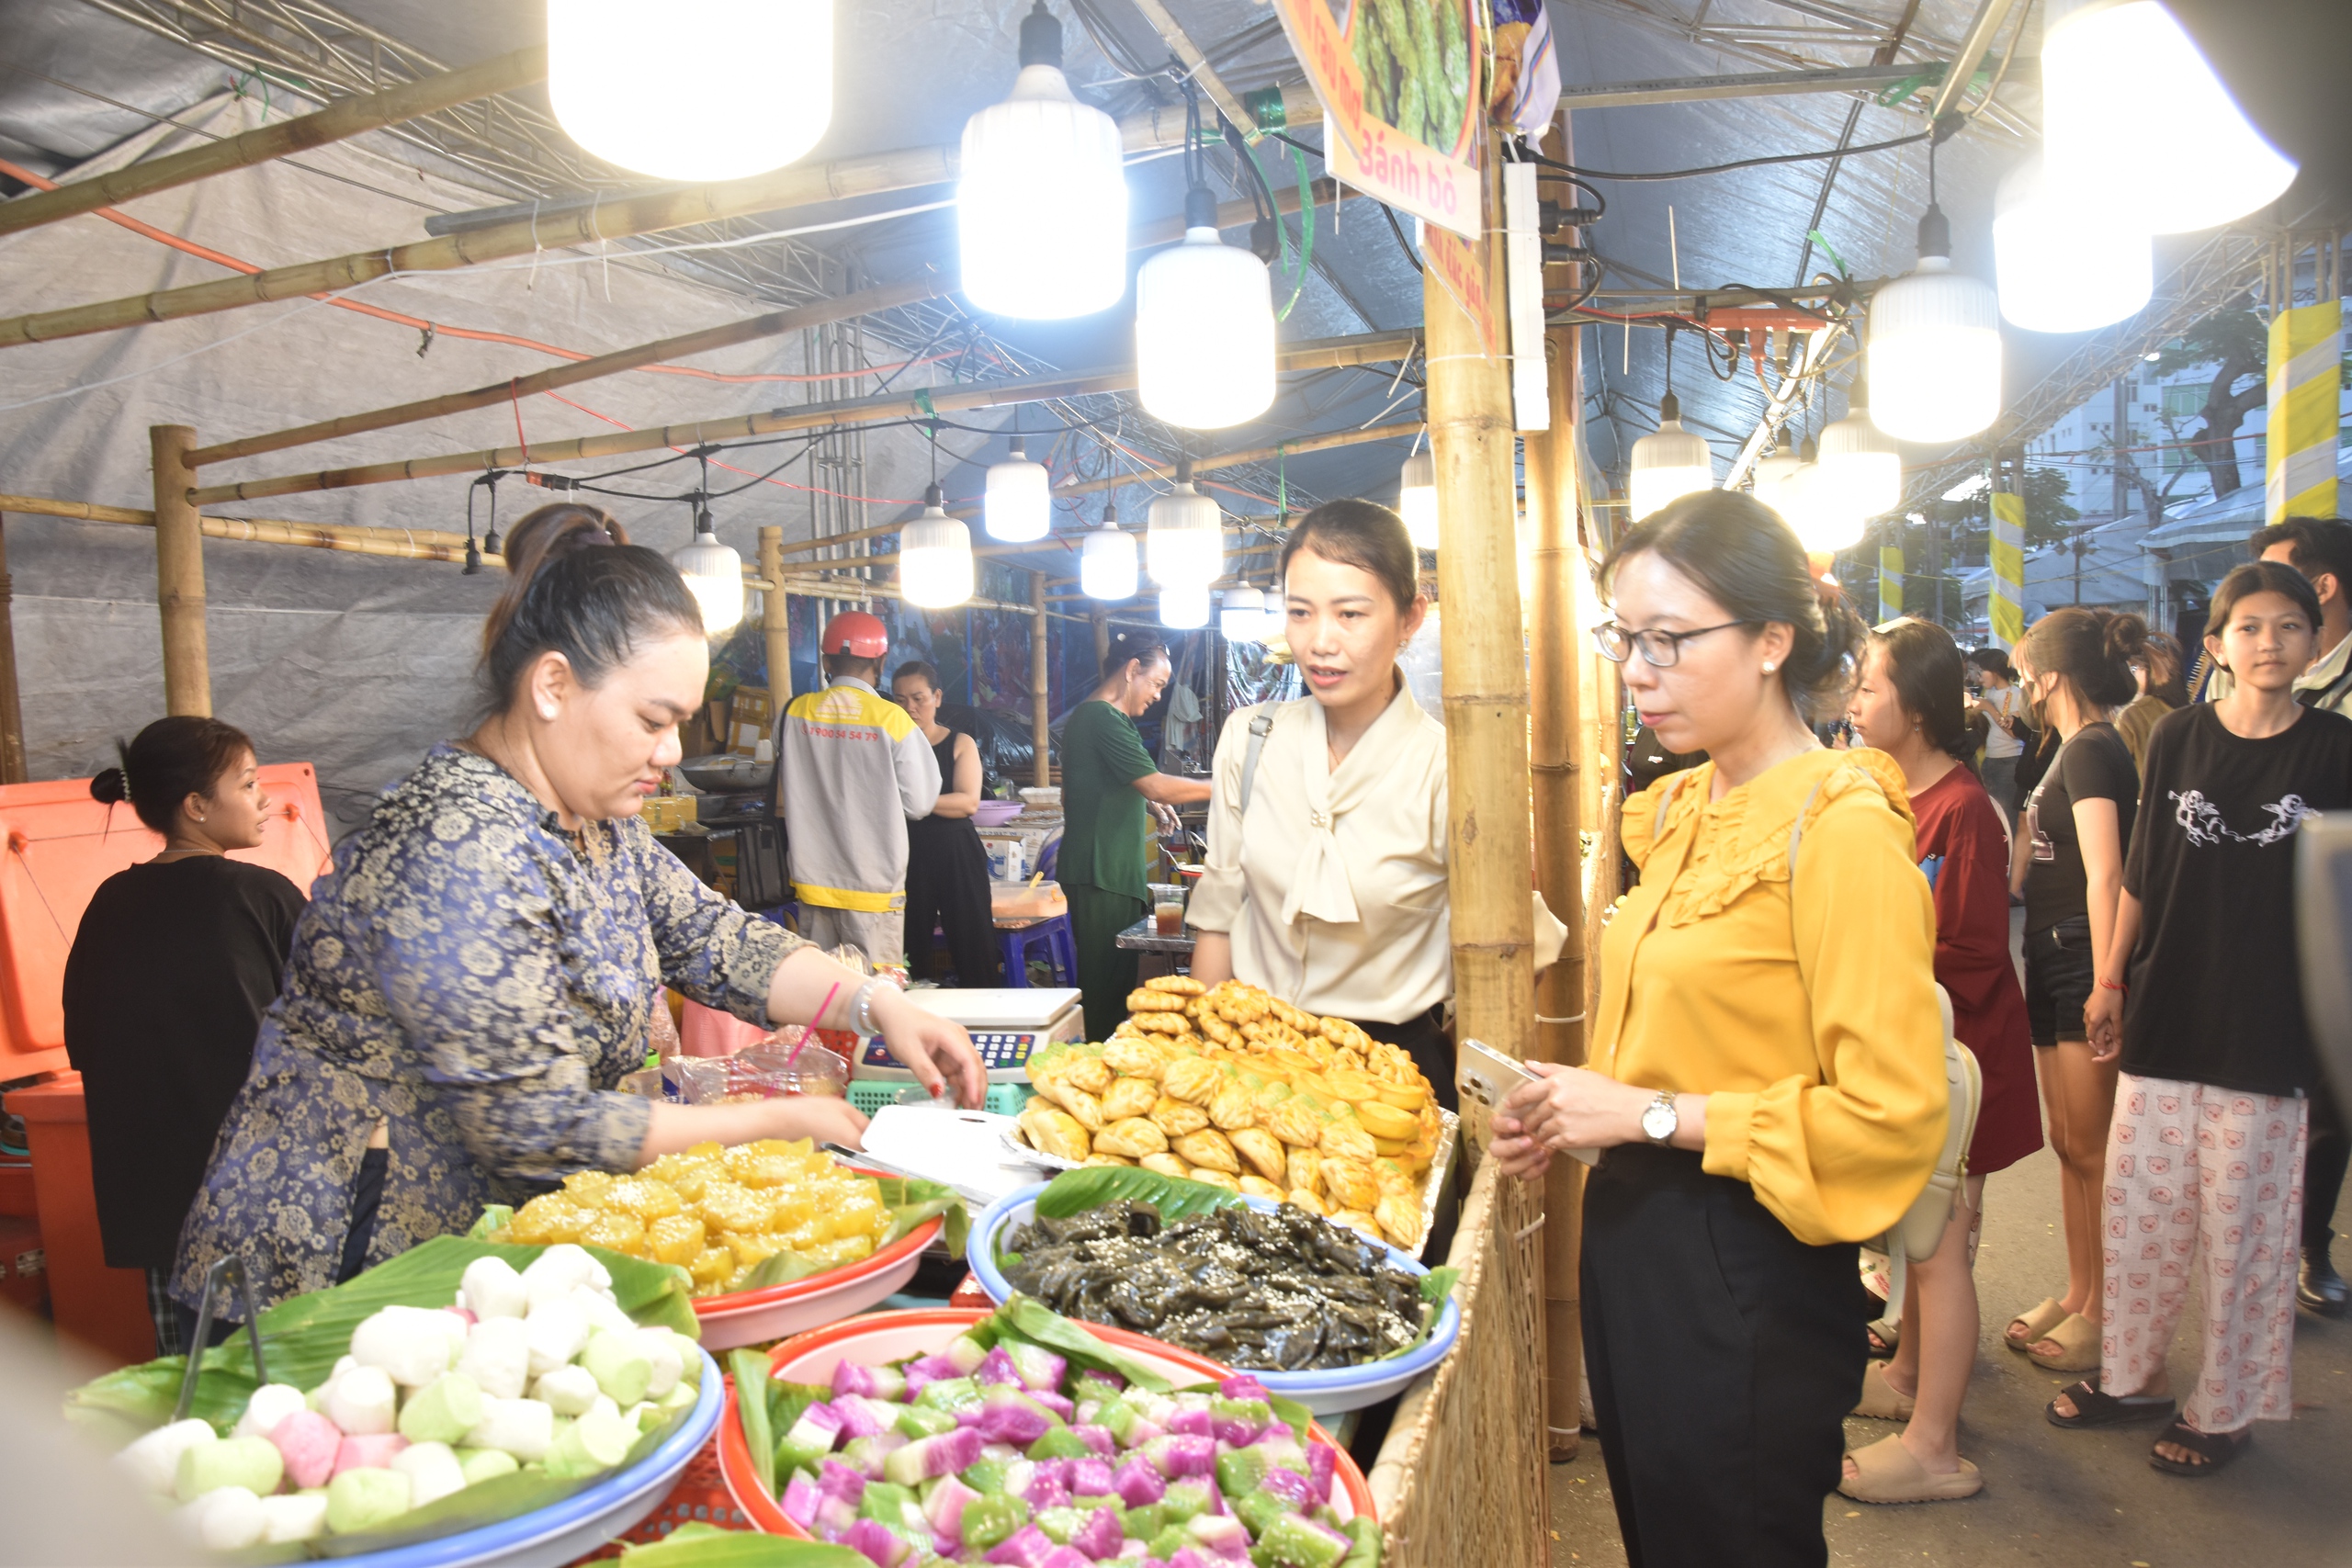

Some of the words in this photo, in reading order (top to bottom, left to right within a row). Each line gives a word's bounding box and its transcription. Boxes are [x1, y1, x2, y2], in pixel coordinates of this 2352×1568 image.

[1427, 160, 1457, 216] bò
[809, 727, 834, 739] 1900
[835, 729, 846, 739] 54
[849, 730, 863, 740] 54
[865, 732, 878, 742] 79
